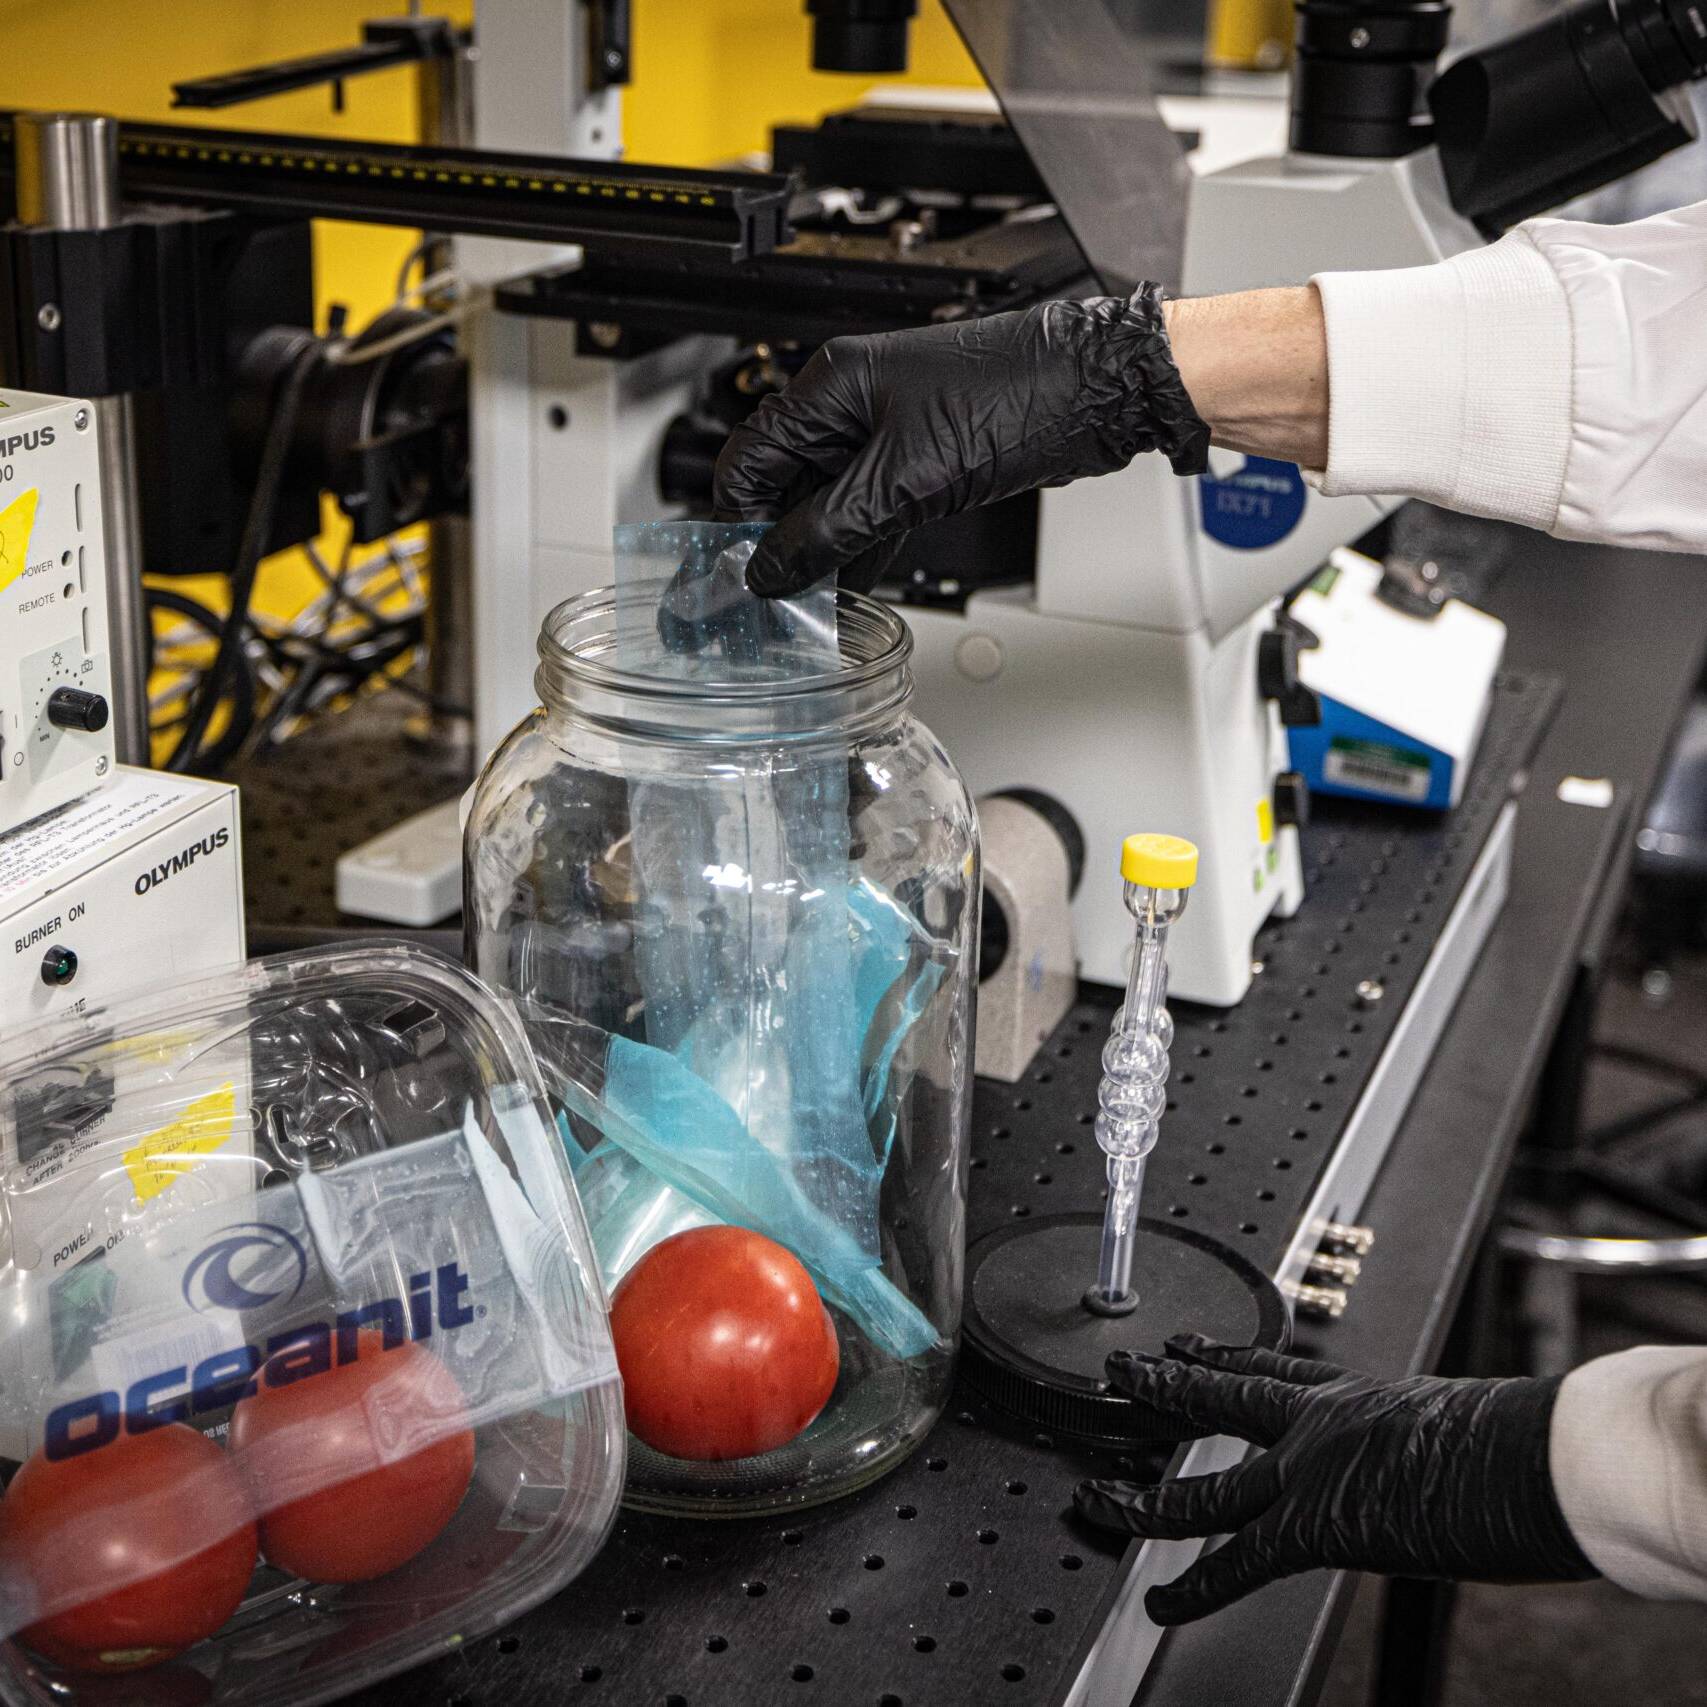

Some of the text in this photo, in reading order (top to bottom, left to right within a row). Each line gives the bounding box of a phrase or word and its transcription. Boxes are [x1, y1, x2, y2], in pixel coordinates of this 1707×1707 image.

[0, 464, 13, 482] 0
[22, 560, 53, 579] POWER
[18, 593, 55, 614] REMOTE
[134, 827, 229, 896] OLYMPUS
[15, 901, 85, 954] BURNER ON
[46, 1263, 474, 1461] oceanit
